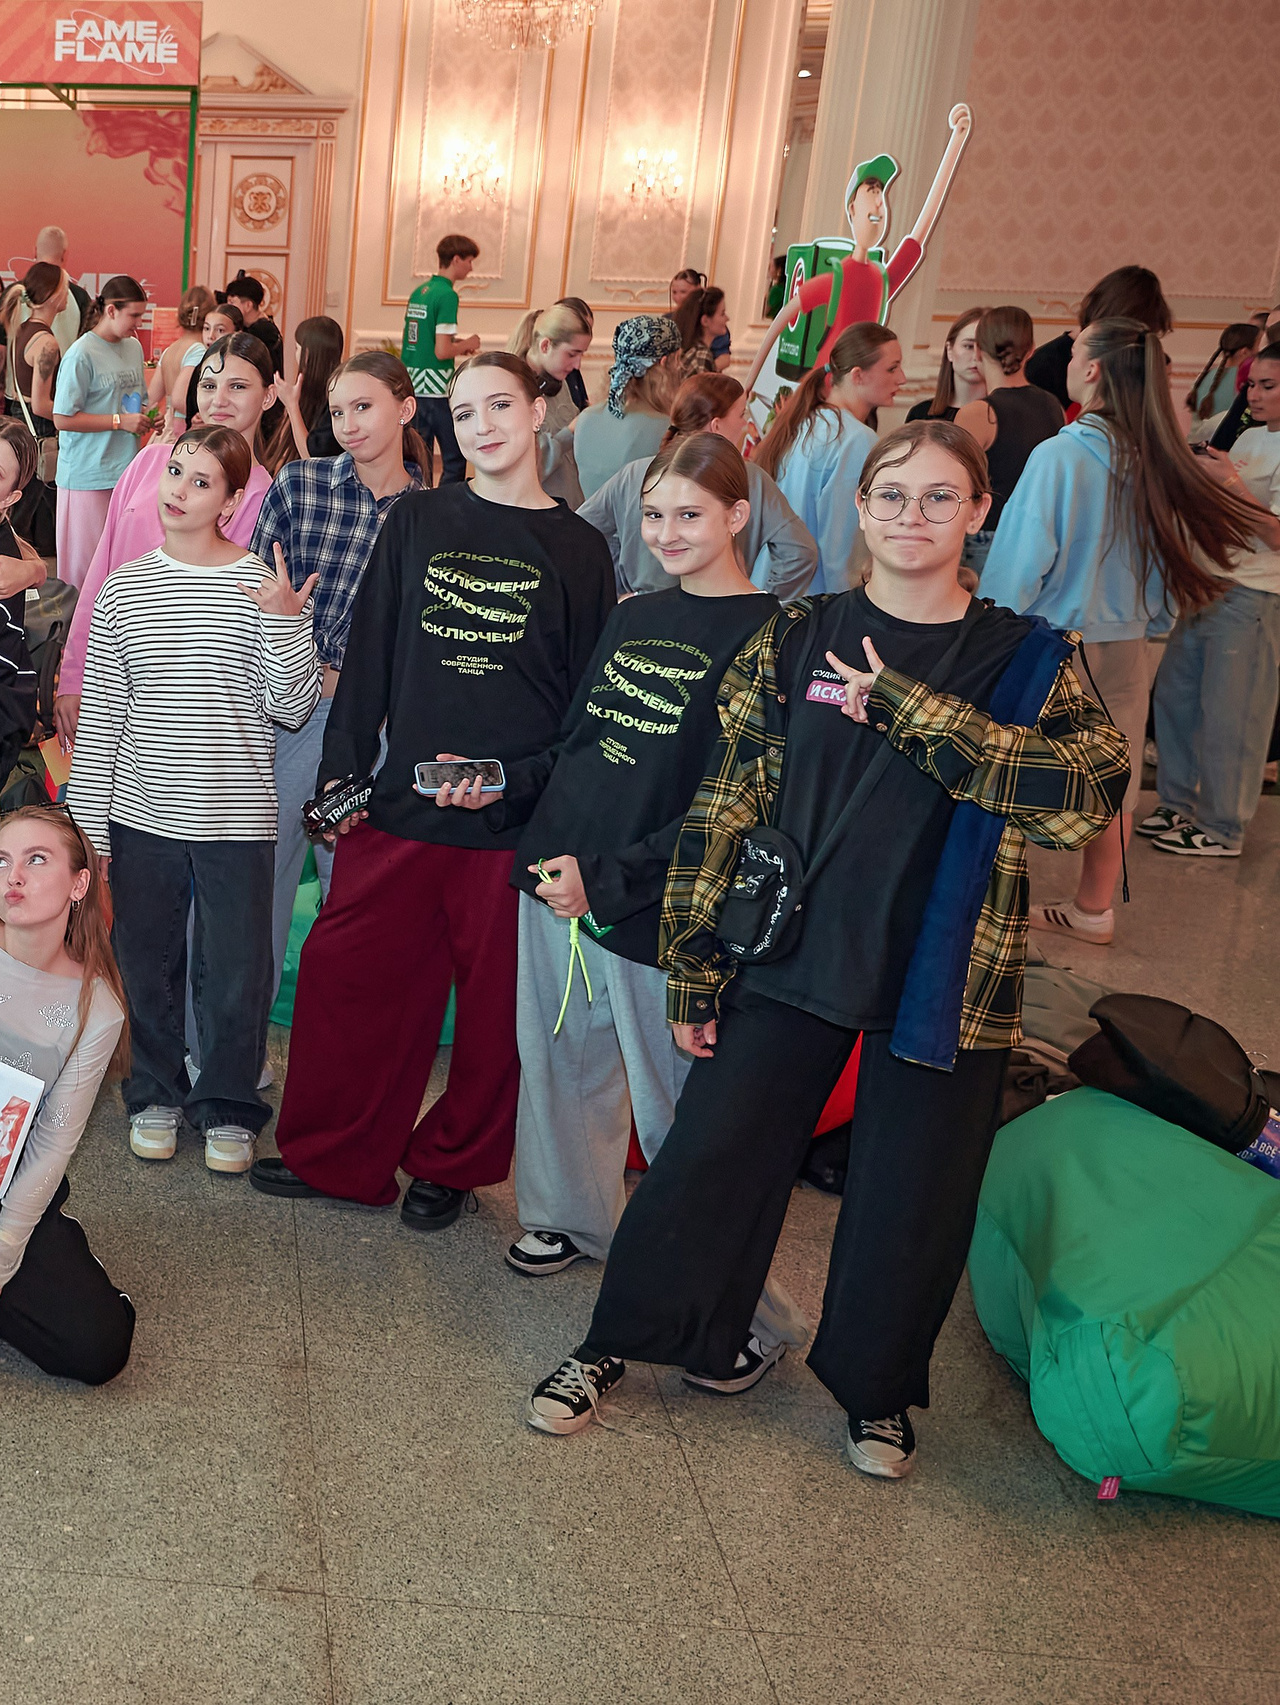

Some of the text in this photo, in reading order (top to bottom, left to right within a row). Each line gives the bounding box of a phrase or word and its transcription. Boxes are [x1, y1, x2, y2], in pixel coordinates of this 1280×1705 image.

[55, 19, 177, 44] FAME to
[54, 41, 178, 64] FLAME
[427, 564, 540, 594] ИСКЛЮЧЕНИЕ
[423, 575, 528, 625] ИСКЛЮЧЕНИЕ
[421, 620, 525, 644] ИСКЛЮЧЕНИЕ
[441, 659, 504, 672] СОВРЕМЕННОГО
[456, 655, 489, 664] СТУДИЯ
[458, 667, 485, 677] ТАНЦА
[586, 701, 680, 735] СКЛЮЧЕНИЕ
[325, 787, 372, 824] ТВИСТЕР
